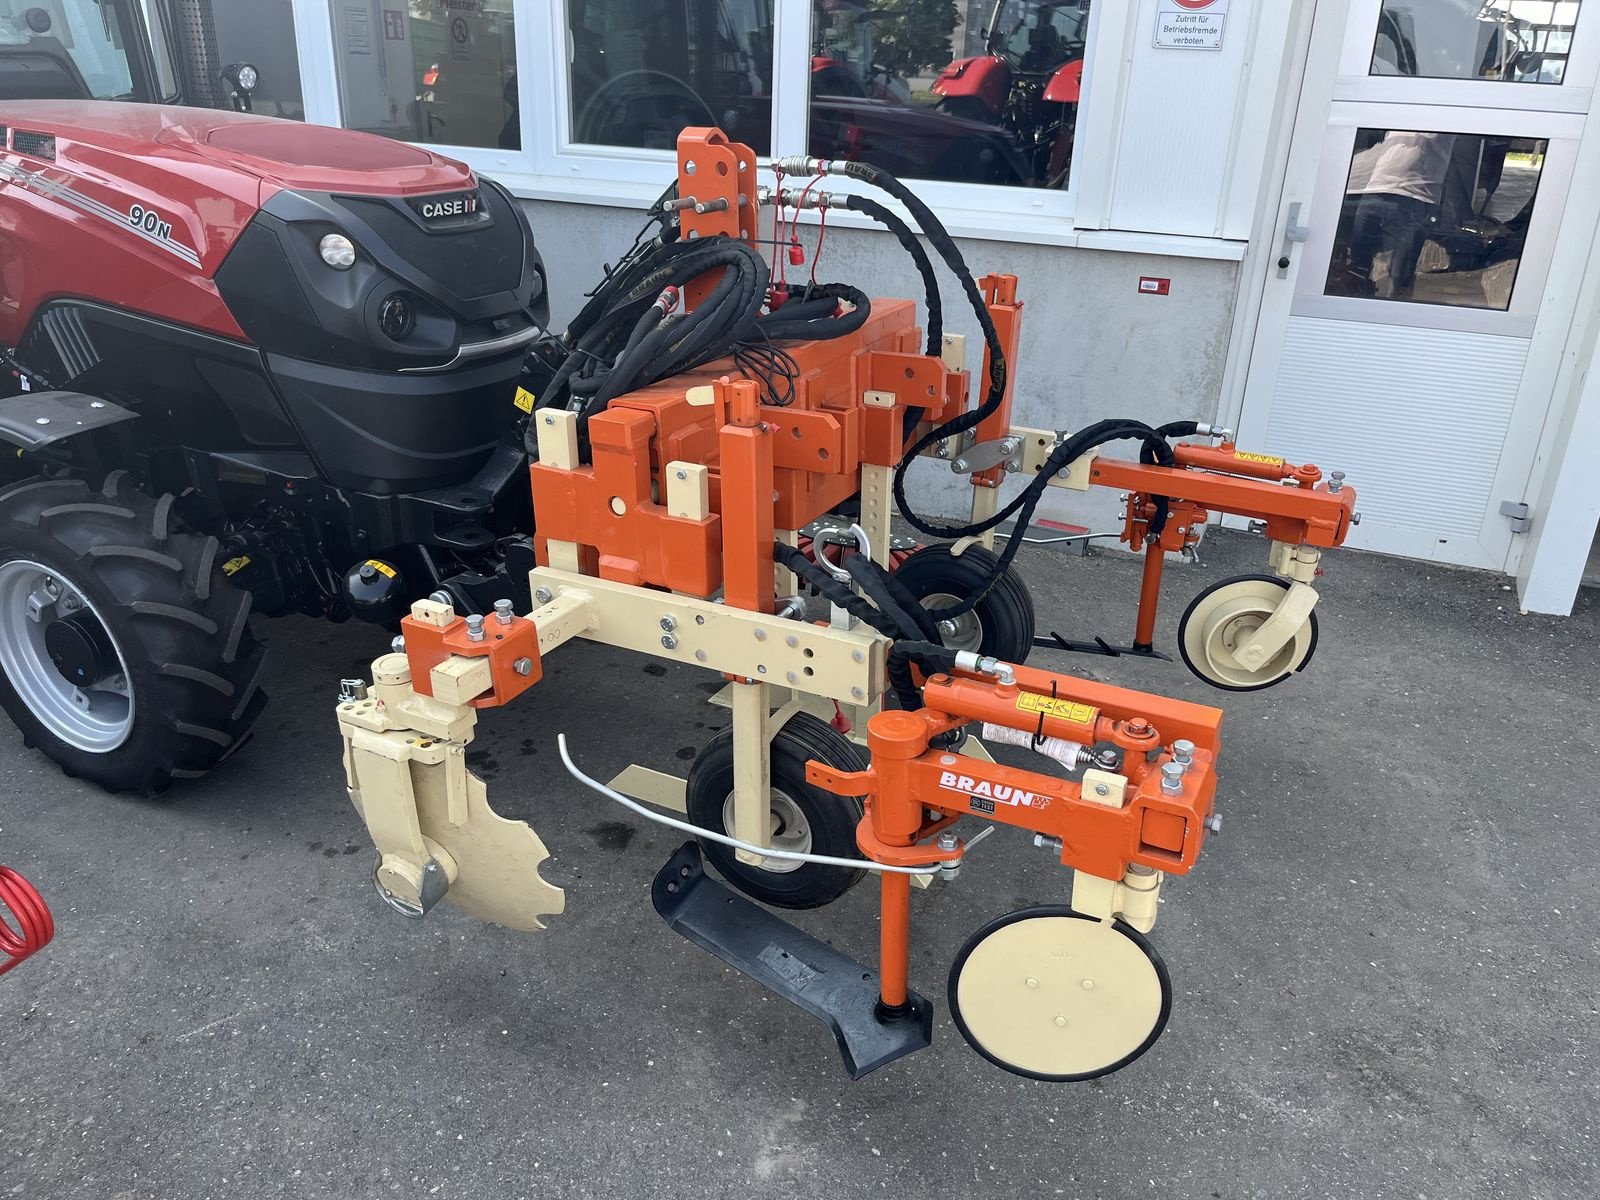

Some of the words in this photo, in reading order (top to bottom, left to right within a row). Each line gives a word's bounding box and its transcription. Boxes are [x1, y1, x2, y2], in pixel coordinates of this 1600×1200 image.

[1175, 15, 1197, 23] Zutritt
[1198, 15, 1209, 23] für
[1163, 25, 1218, 35] Betriebsfremde
[1173, 37, 1204, 45] verboten
[422, 201, 463, 218] CASE
[129, 204, 172, 240] 90N
[939, 771, 1033, 806] BRAUN
